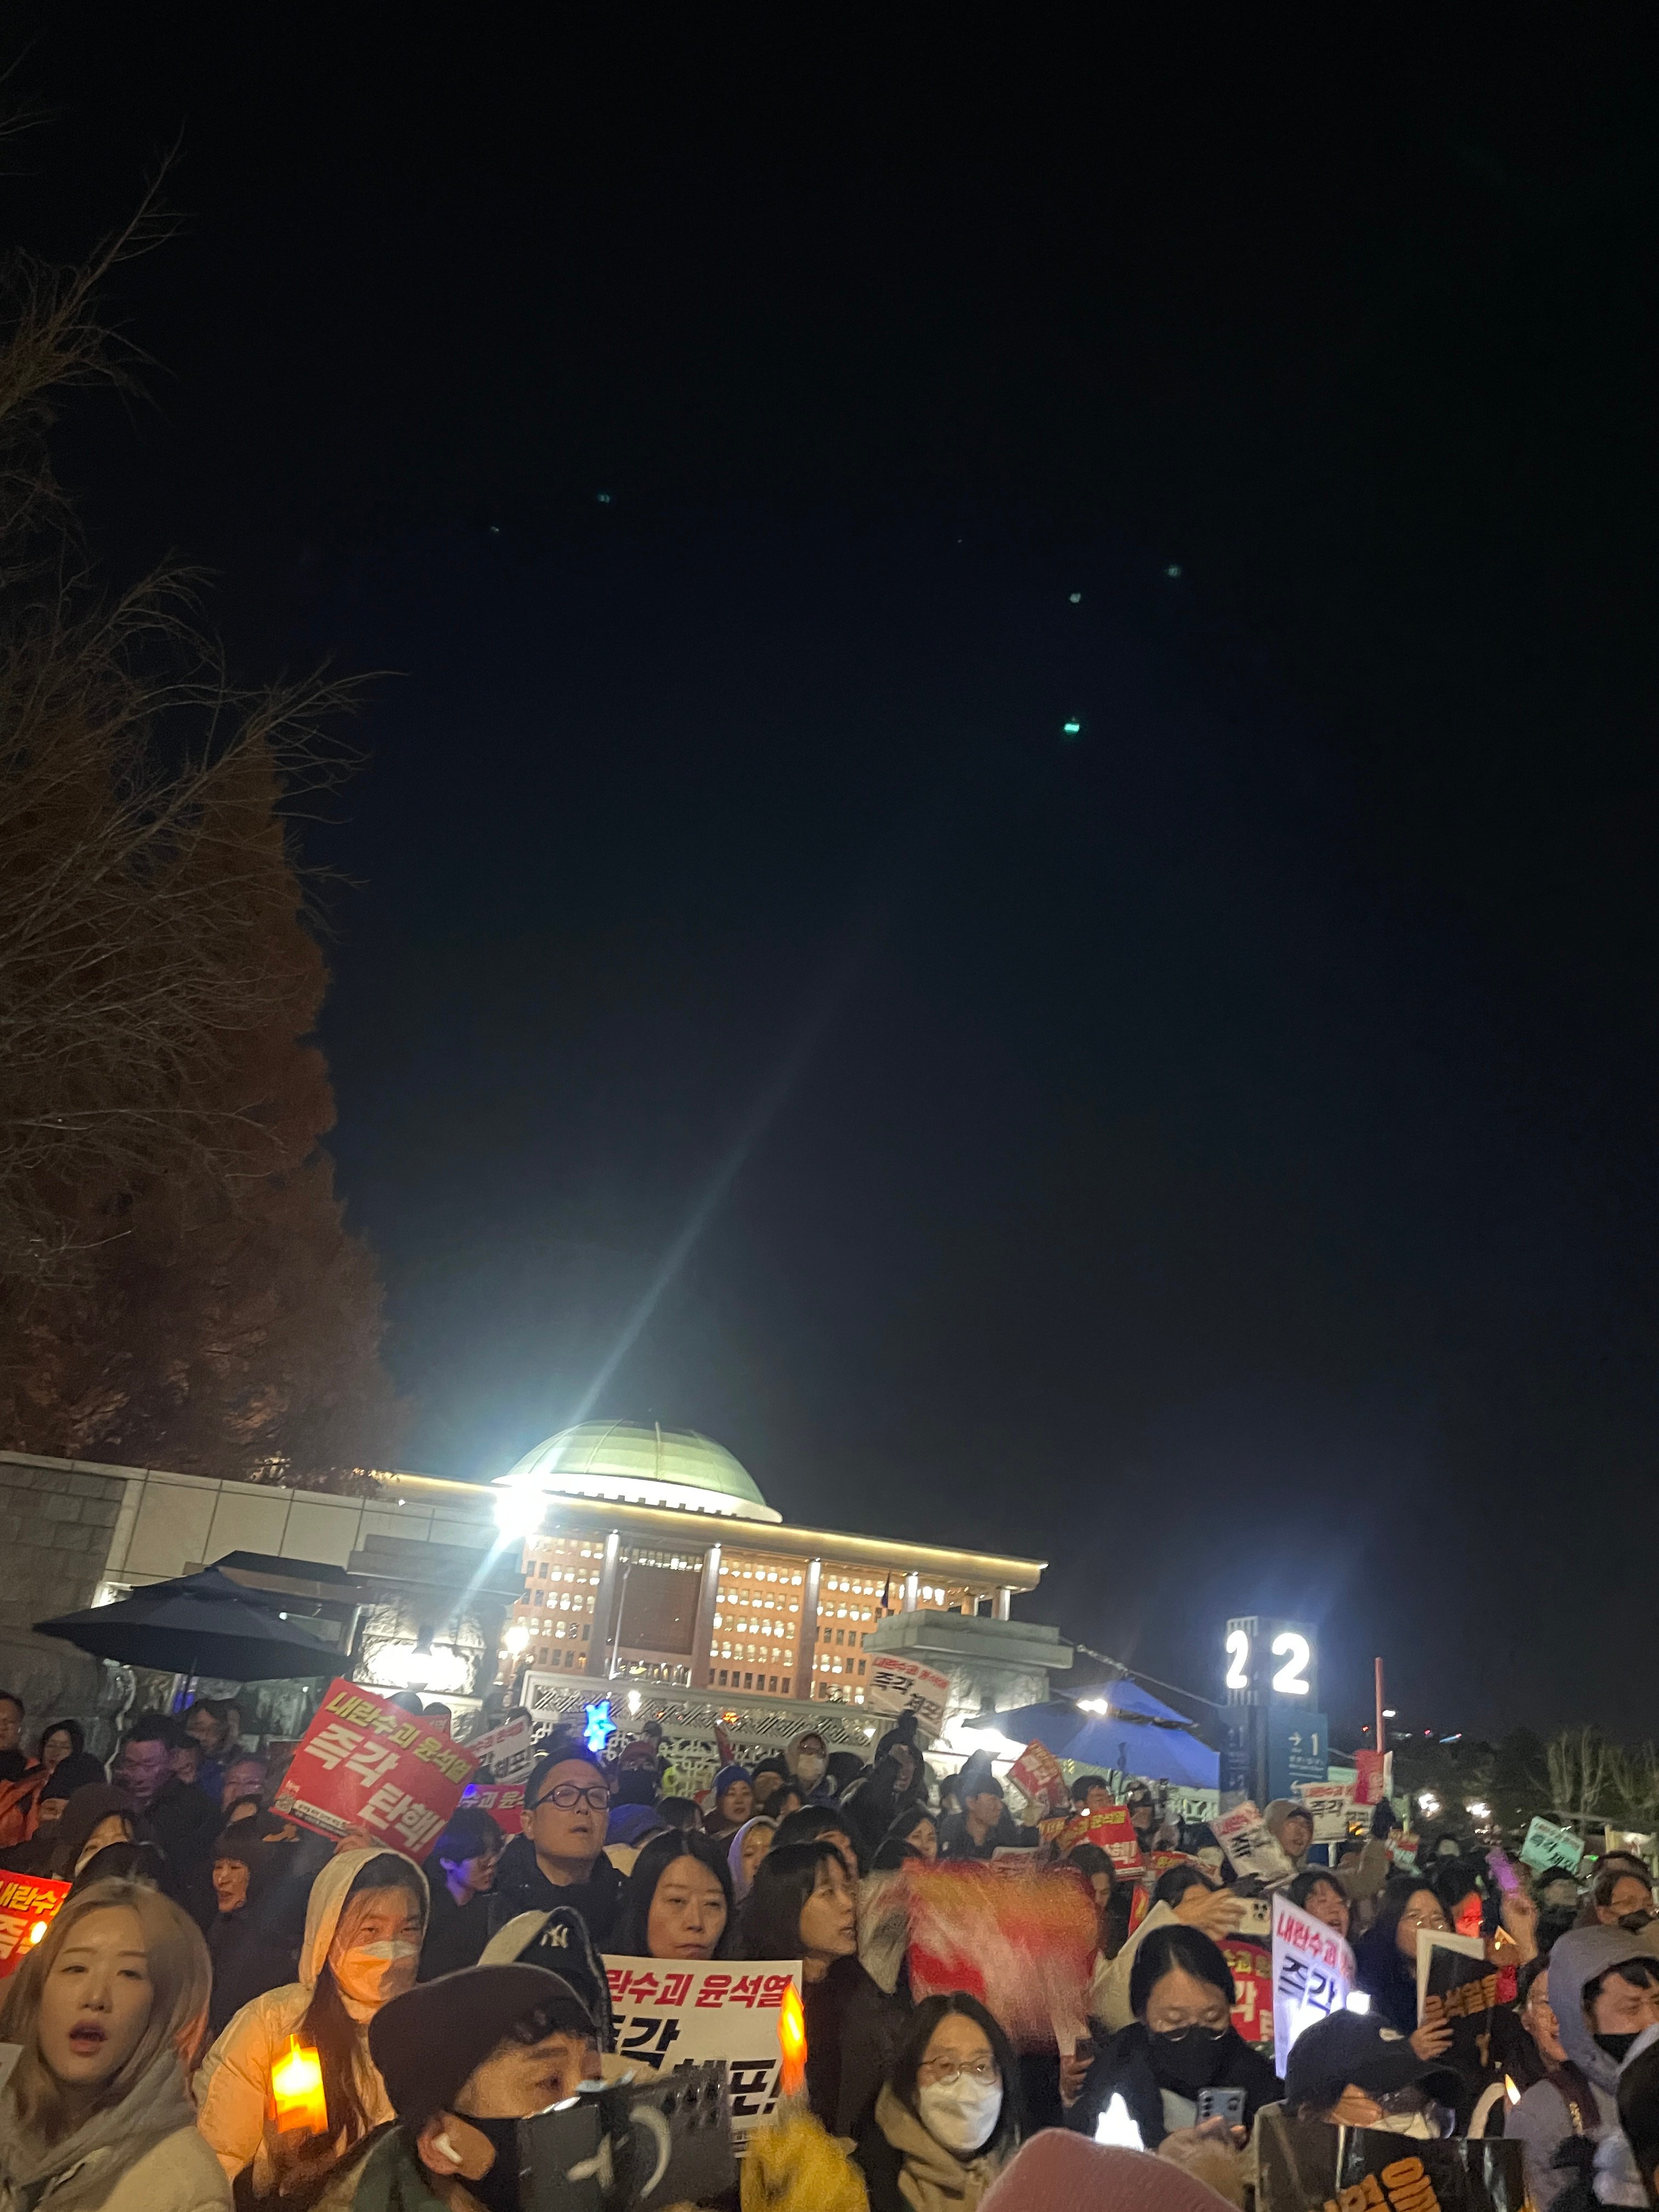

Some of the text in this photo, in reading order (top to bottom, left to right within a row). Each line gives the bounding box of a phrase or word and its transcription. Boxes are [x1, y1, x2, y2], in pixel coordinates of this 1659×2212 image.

[1226, 1630, 1248, 1689] 2
[1272, 1633, 1310, 1695] 2
[303, 1723, 401, 1788] 즉각
[325, 1691, 421, 1749] 내란수괴
[412, 1736, 472, 1784] 윤석열
[1311, 1733, 1318, 1756] 1
[357, 1783, 447, 1853] 탄핵!
[498, 1791, 525, 1809] 윤
[0, 1881, 67, 1916] 내란수
[1276, 1910, 1337, 1969] 내란수괴
[695, 1974, 794, 2008] 윤석열
[1277, 1955, 1335, 2017] 즉각
